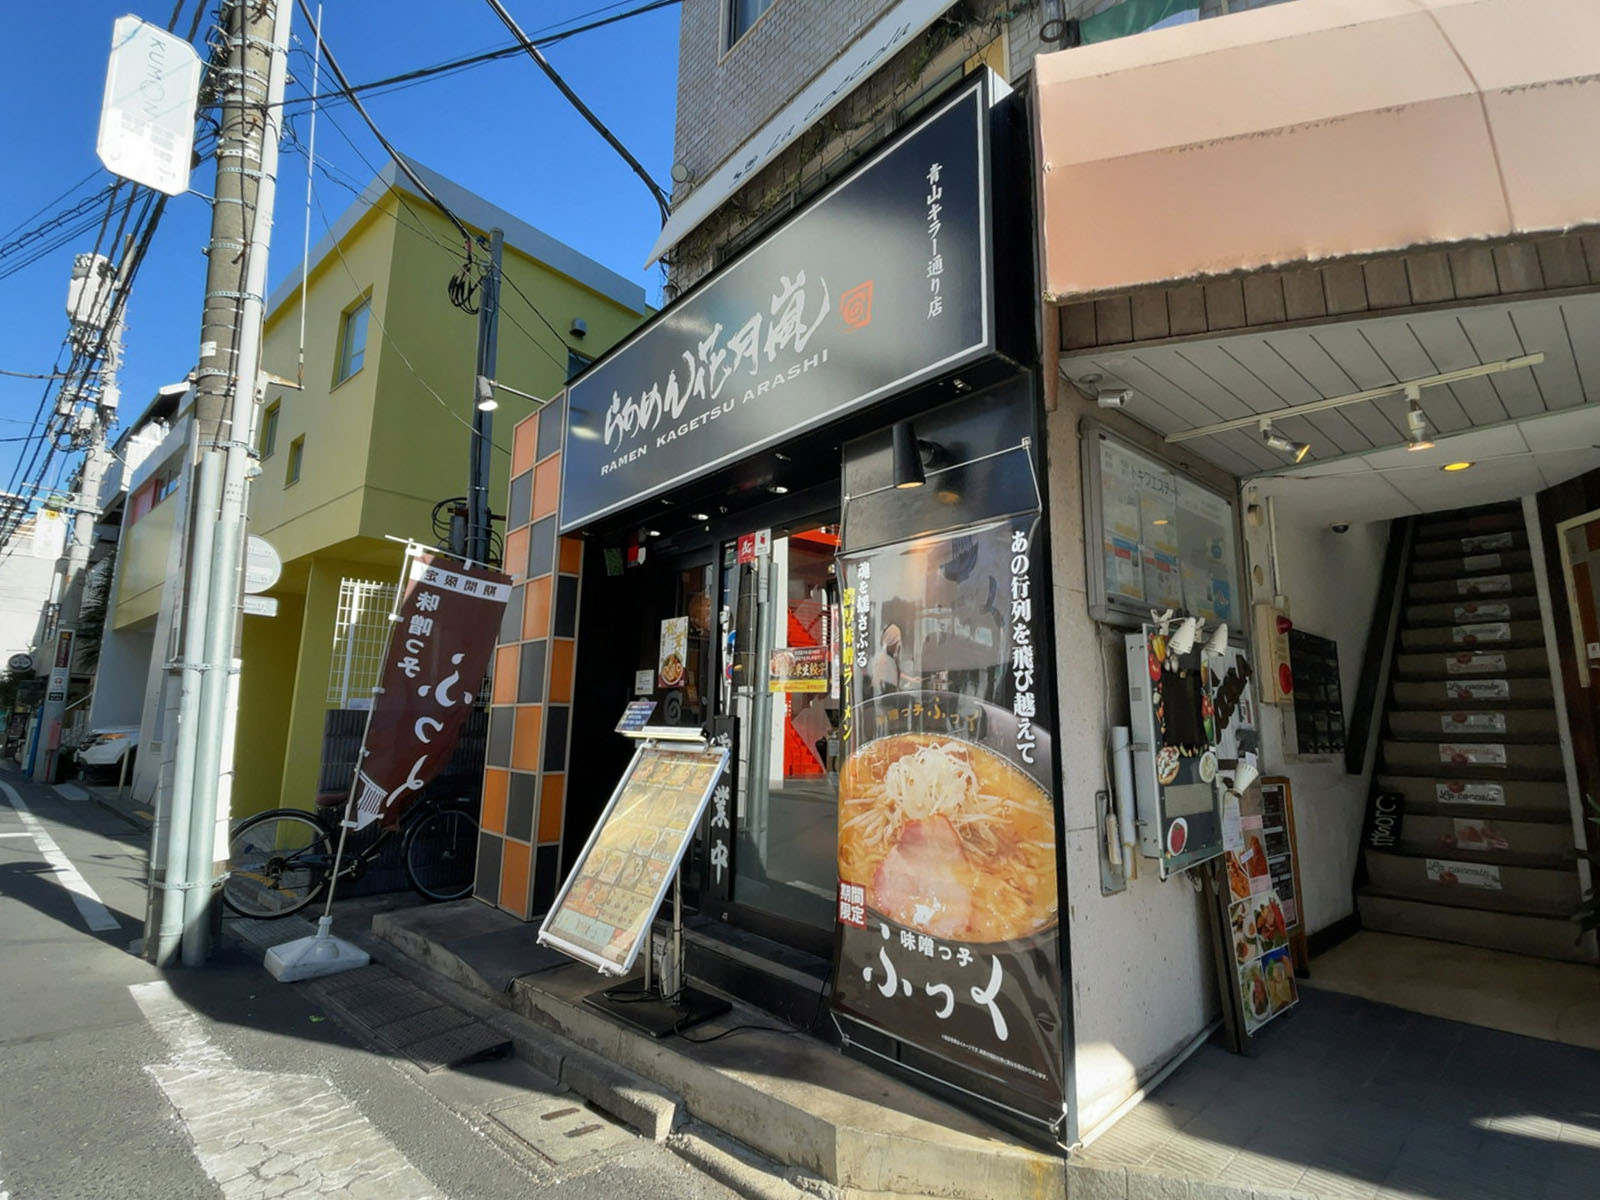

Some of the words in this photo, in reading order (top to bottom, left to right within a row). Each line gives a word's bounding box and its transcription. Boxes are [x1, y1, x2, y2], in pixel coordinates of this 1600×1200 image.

[139, 37, 166, 121] KUMON
[926, 162, 944, 320] 青山キラー通り店
[601, 444, 647, 477] RAMEN
[656, 398, 735, 449] KAGETSU
[742, 348, 829, 404] ARASHI
[1011, 530, 1036, 764] あの行列を飛び越えて
[900, 929, 974, 968] 味噌っ子
